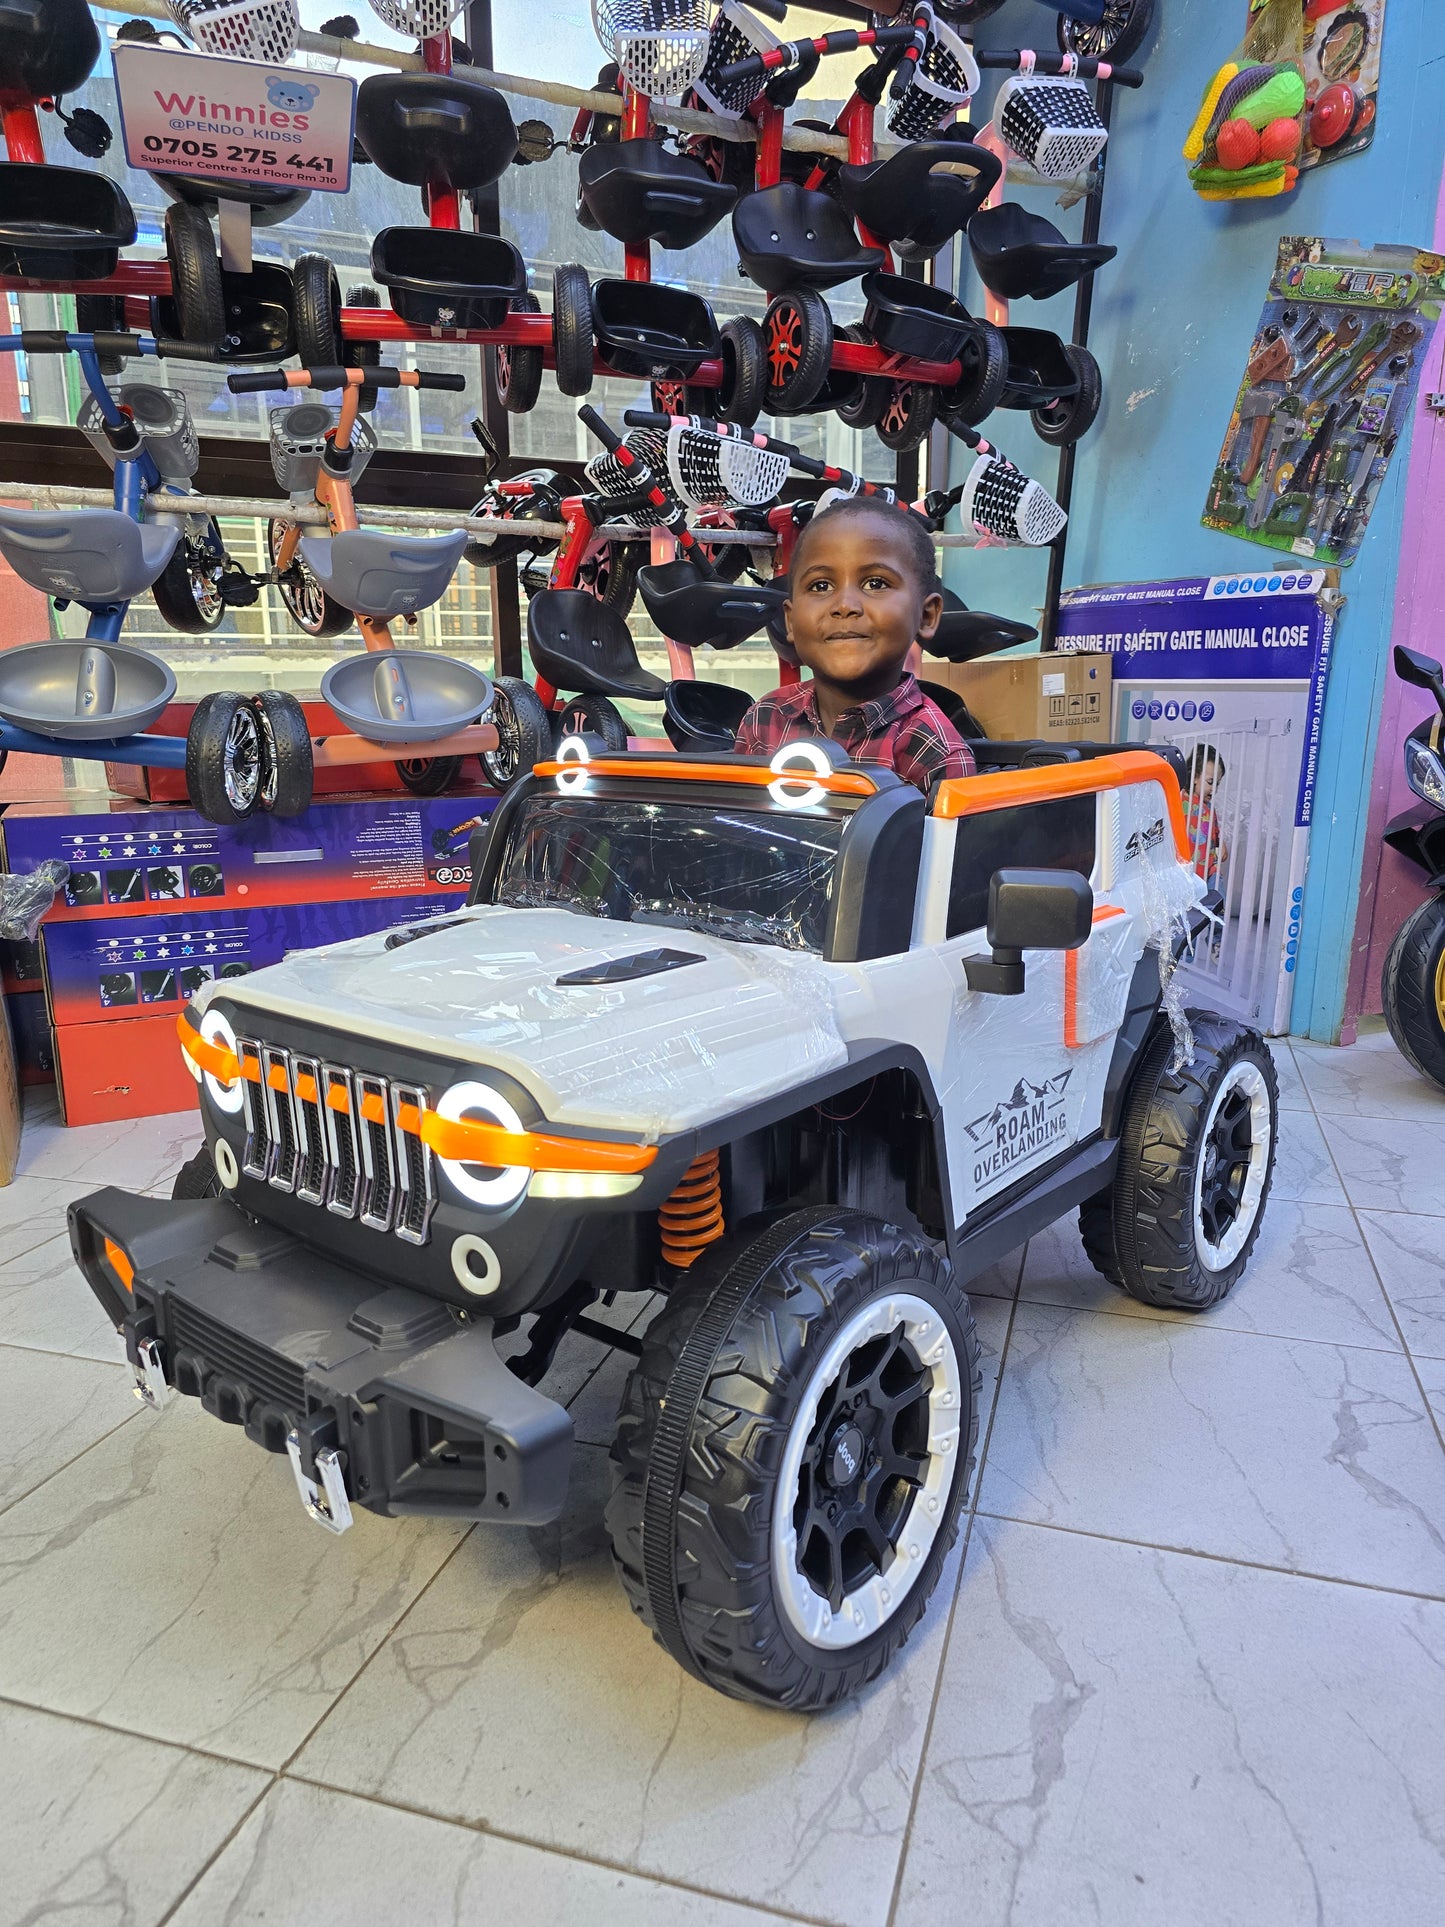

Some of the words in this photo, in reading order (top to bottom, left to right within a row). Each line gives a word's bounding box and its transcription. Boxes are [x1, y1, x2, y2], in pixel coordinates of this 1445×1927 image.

[153, 90, 310, 131] Winnies
[169, 118, 303, 144] @PENDO_KIDSS
[140, 154, 193, 168] Superior
[197, 160, 238, 173] Centre
[240, 165, 260, 176] 3rd
[263, 168, 294, 180] Floor
[297, 173, 317, 182] Rm
[319, 175, 338, 185] J10
[143, 135, 218, 158] 0705
[227, 145, 278, 166] 275
[286, 153, 334, 173] 441
[1360, 363, 1376, 380] TOOLS
[1311, 451, 1321, 472] TOOLS
[1100, 592, 1127, 602] SAFETY
[1126, 589, 1146, 600] GATE
[1145, 588, 1175, 599] MANUAL
[1176, 586, 1203, 596] CLOSE
[1104, 633, 1123, 652] FIT
[1123, 631, 1168, 652] SAFETY
[1170, 629, 1203, 651] GATE
[1204, 630, 1259, 649] MANUAL
[1261, 625, 1310, 648] CLOSE
[1318, 656, 1328, 673] FIT
[1313, 675, 1326, 714] SAFETY
[1310, 716, 1320, 744] GATE
[1305, 745, 1317, 788] MANUAL
[1301, 789, 1312, 822] CLOSE
[996, 1100, 1045, 1149] ROAM
[974, 1112, 1067, 1184] OVERLANDING
